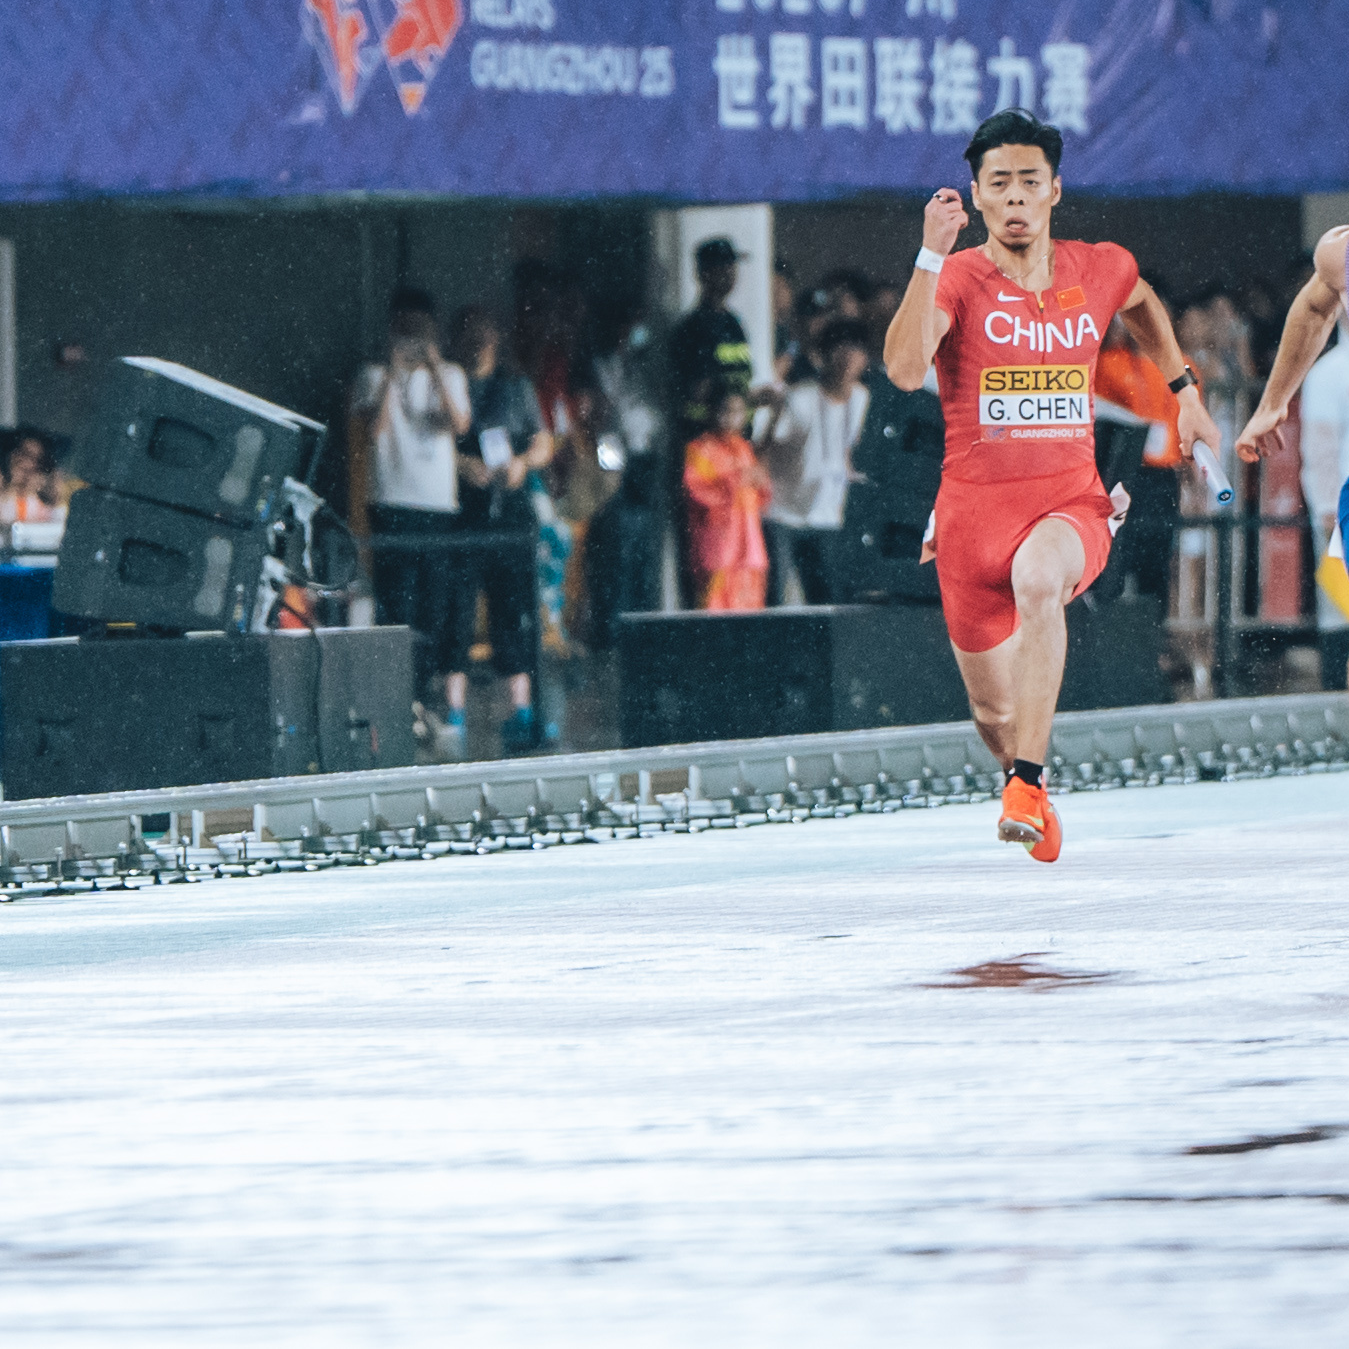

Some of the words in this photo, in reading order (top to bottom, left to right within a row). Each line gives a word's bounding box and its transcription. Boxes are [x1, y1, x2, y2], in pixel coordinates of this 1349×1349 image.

[470, 40, 637, 96] GUANGZHOU
[639, 46, 675, 97] 25
[712, 32, 1092, 136] 世界田联接力赛
[984, 311, 1099, 352] CHINA
[985, 369, 1085, 391] SEIKO
[988, 399, 1011, 420] G.
[1018, 397, 1083, 420] CHEN
[1011, 429, 1074, 439] GUANGZHOU
[1075, 428, 1087, 438] 25
